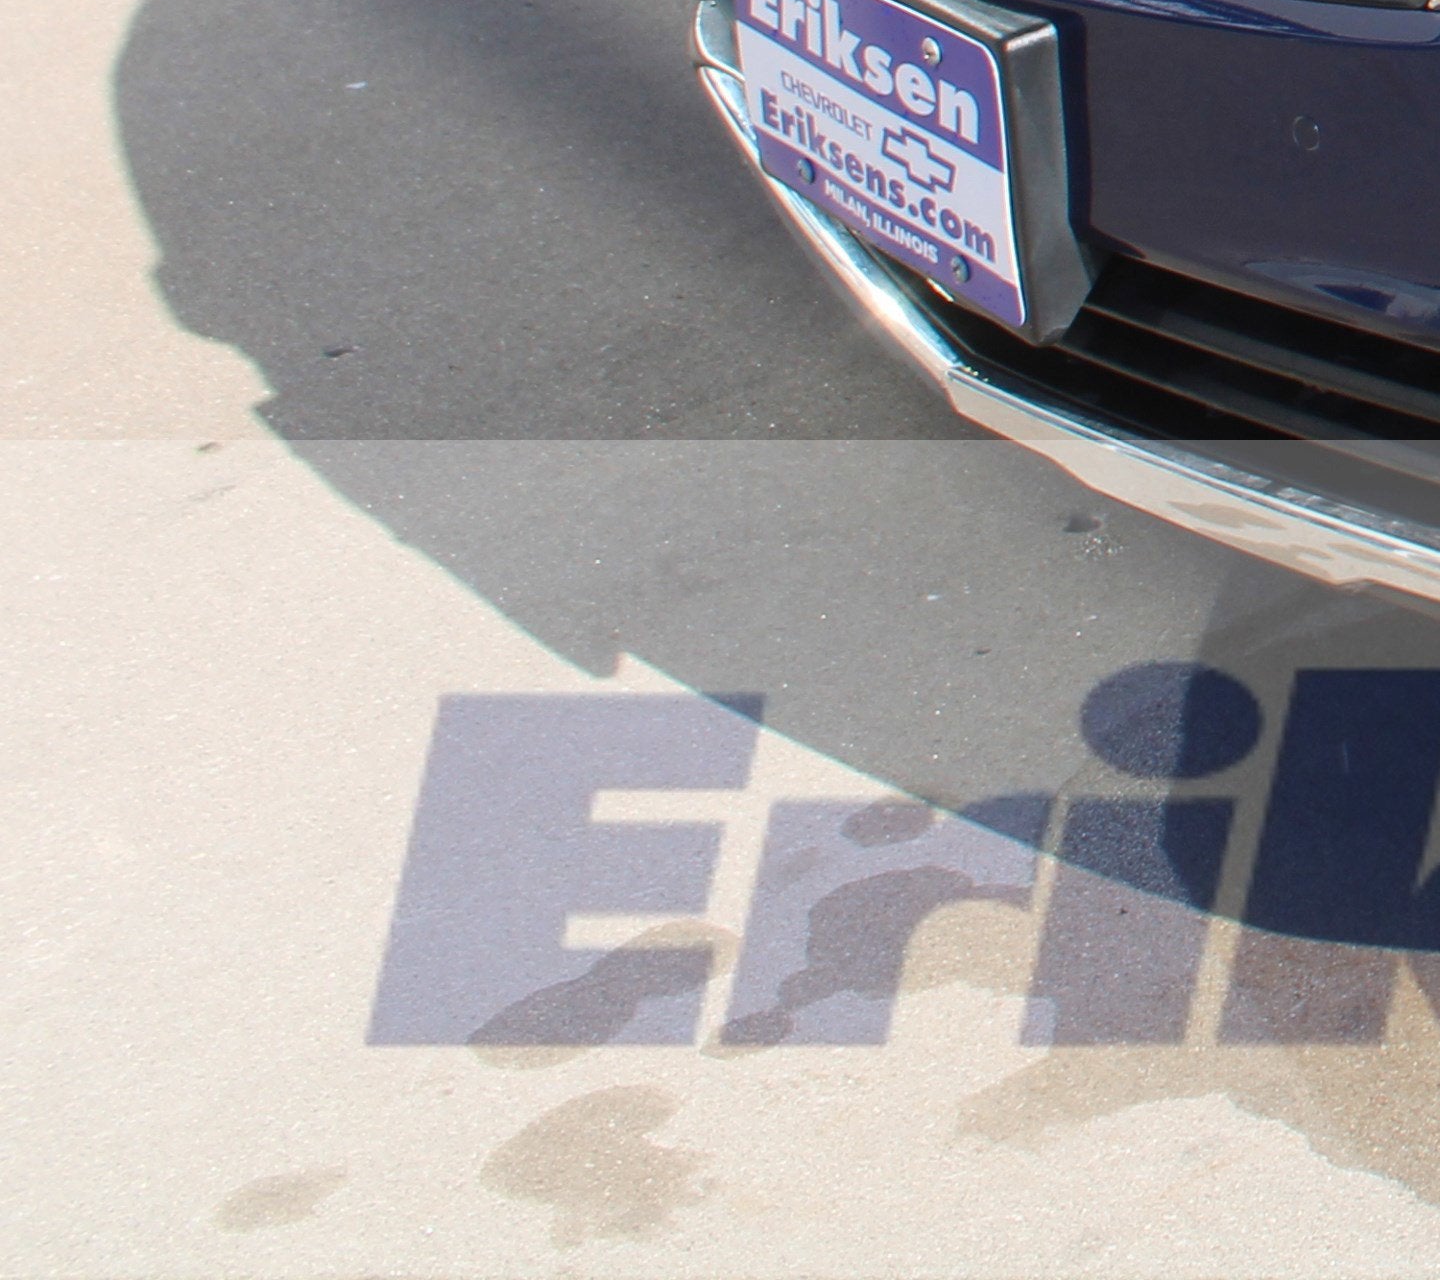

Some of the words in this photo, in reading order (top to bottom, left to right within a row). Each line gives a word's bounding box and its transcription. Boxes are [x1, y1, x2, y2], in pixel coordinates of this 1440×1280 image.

[780, 69, 874, 139] CHEVROLET
[760, 88, 998, 264] Eriksens.com
[823, 177, 871, 230] MILAN,
[871, 213, 940, 264] ILLINOIS
